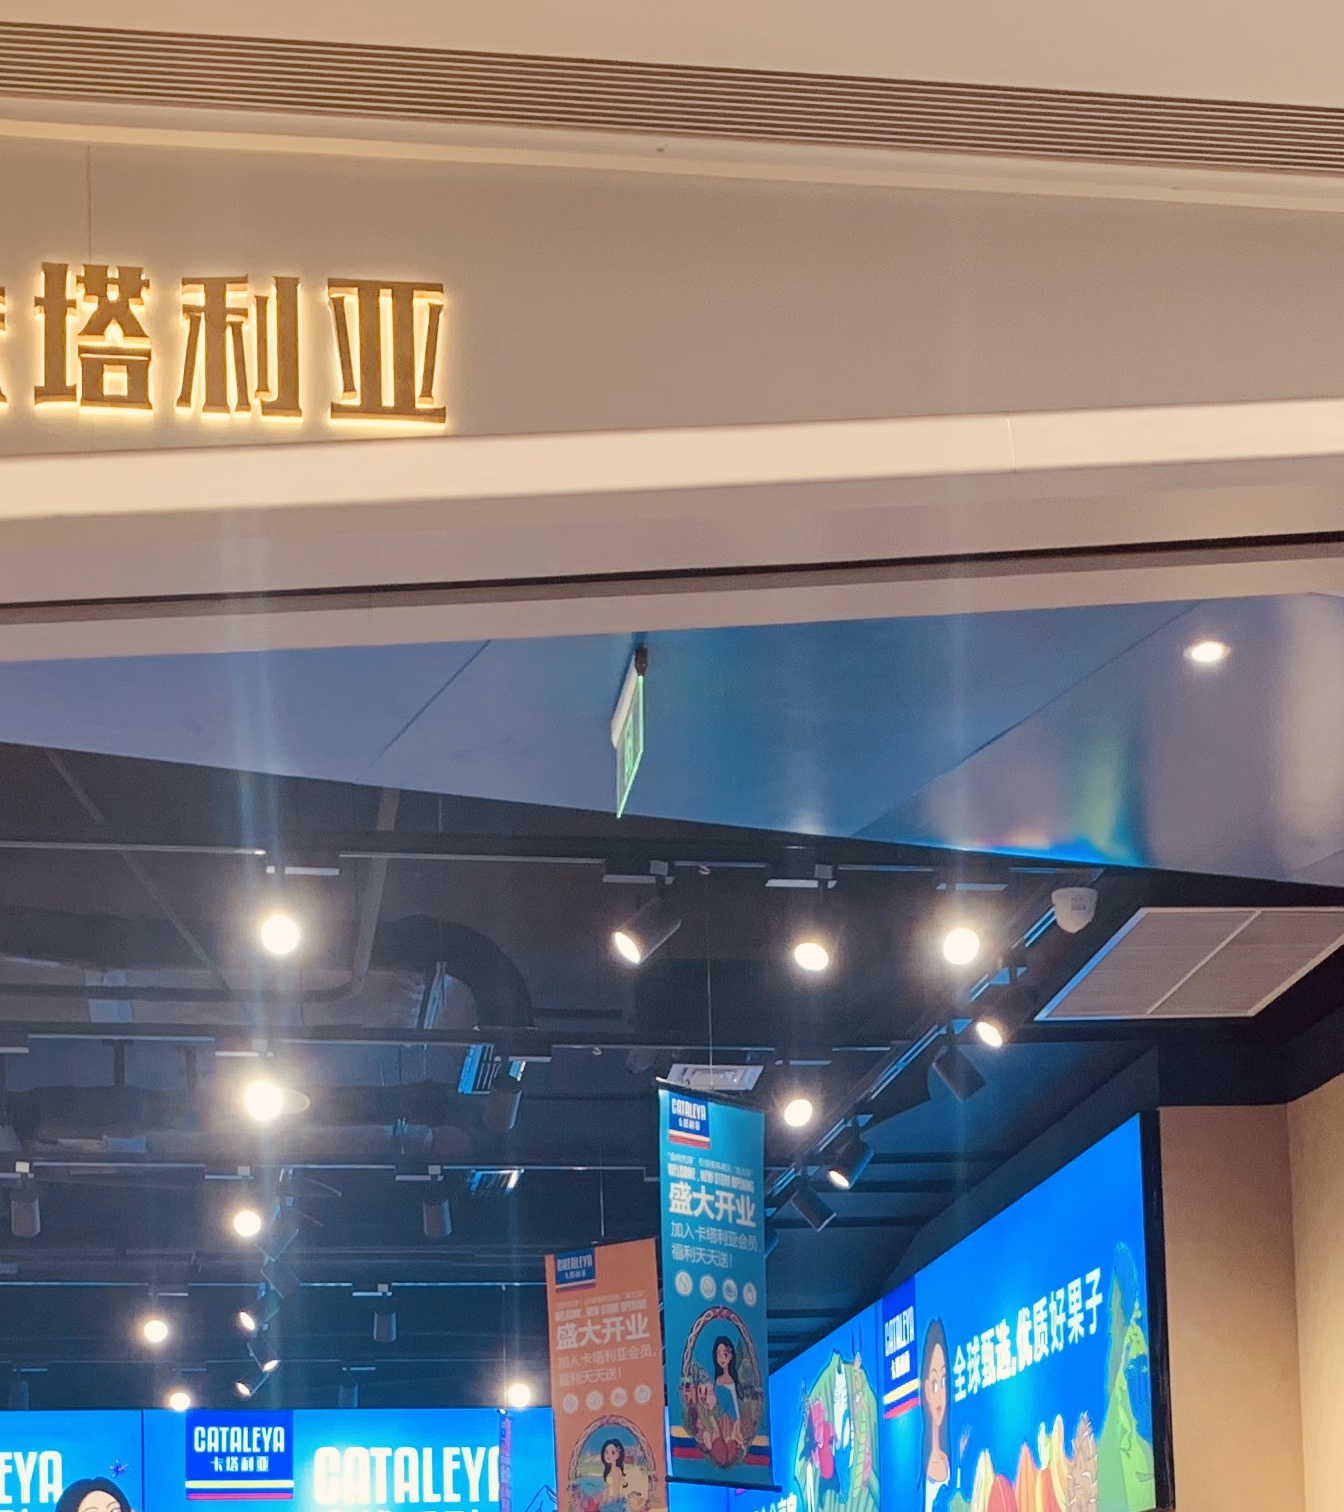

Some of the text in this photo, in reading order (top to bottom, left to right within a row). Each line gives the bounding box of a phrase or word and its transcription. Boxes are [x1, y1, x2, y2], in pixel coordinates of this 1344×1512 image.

[668, 1180, 757, 1229] 盛大开业
[557, 1312, 650, 1351] 盛大开业
[194, 1425, 285, 1453] CATALEYA
